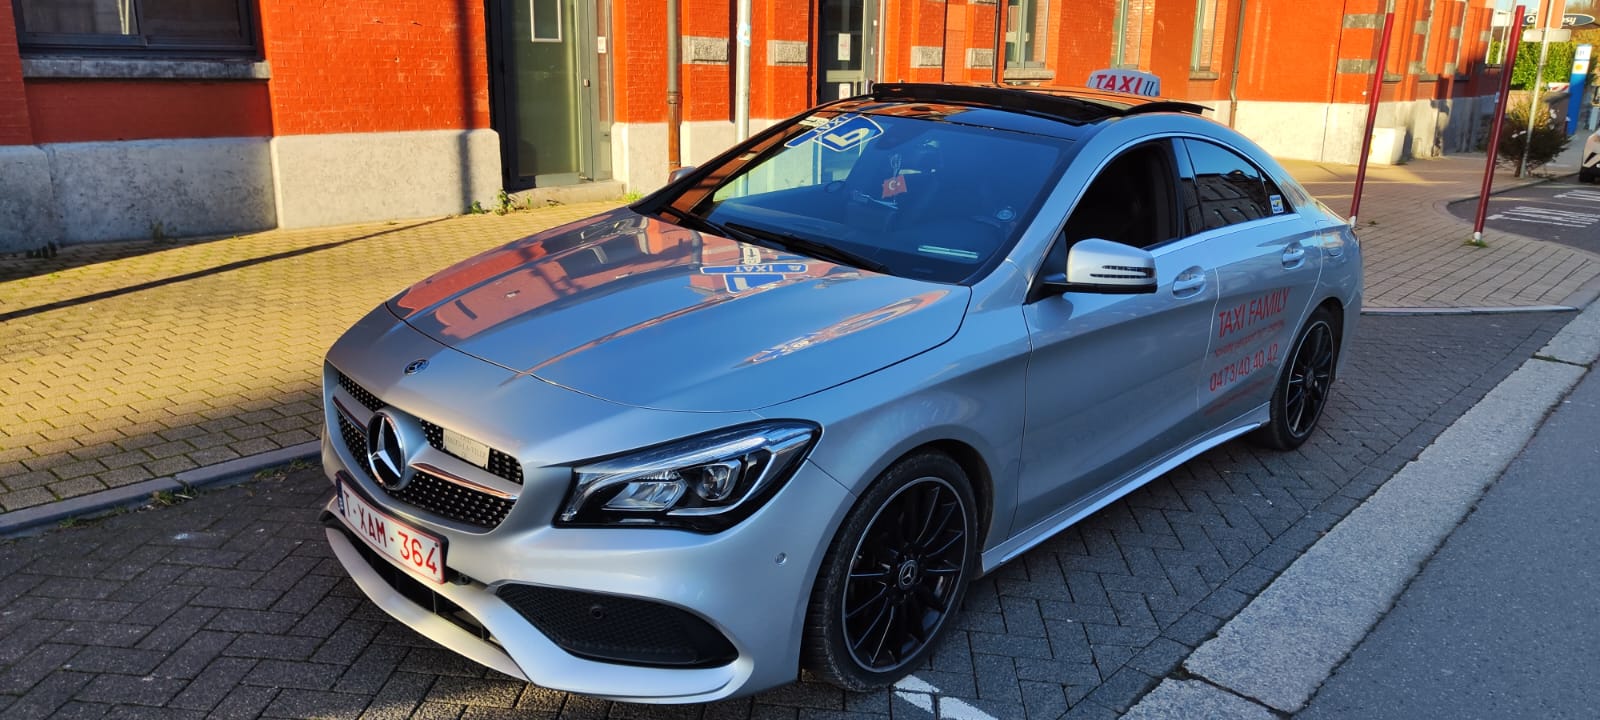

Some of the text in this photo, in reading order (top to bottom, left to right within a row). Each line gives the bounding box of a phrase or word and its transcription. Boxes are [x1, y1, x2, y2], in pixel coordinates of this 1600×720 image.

[1096, 74, 1143, 95] TAXI
[1219, 287, 1291, 338] TAXI FAMILY
[343, 491, 438, 575] T-XAM-364
